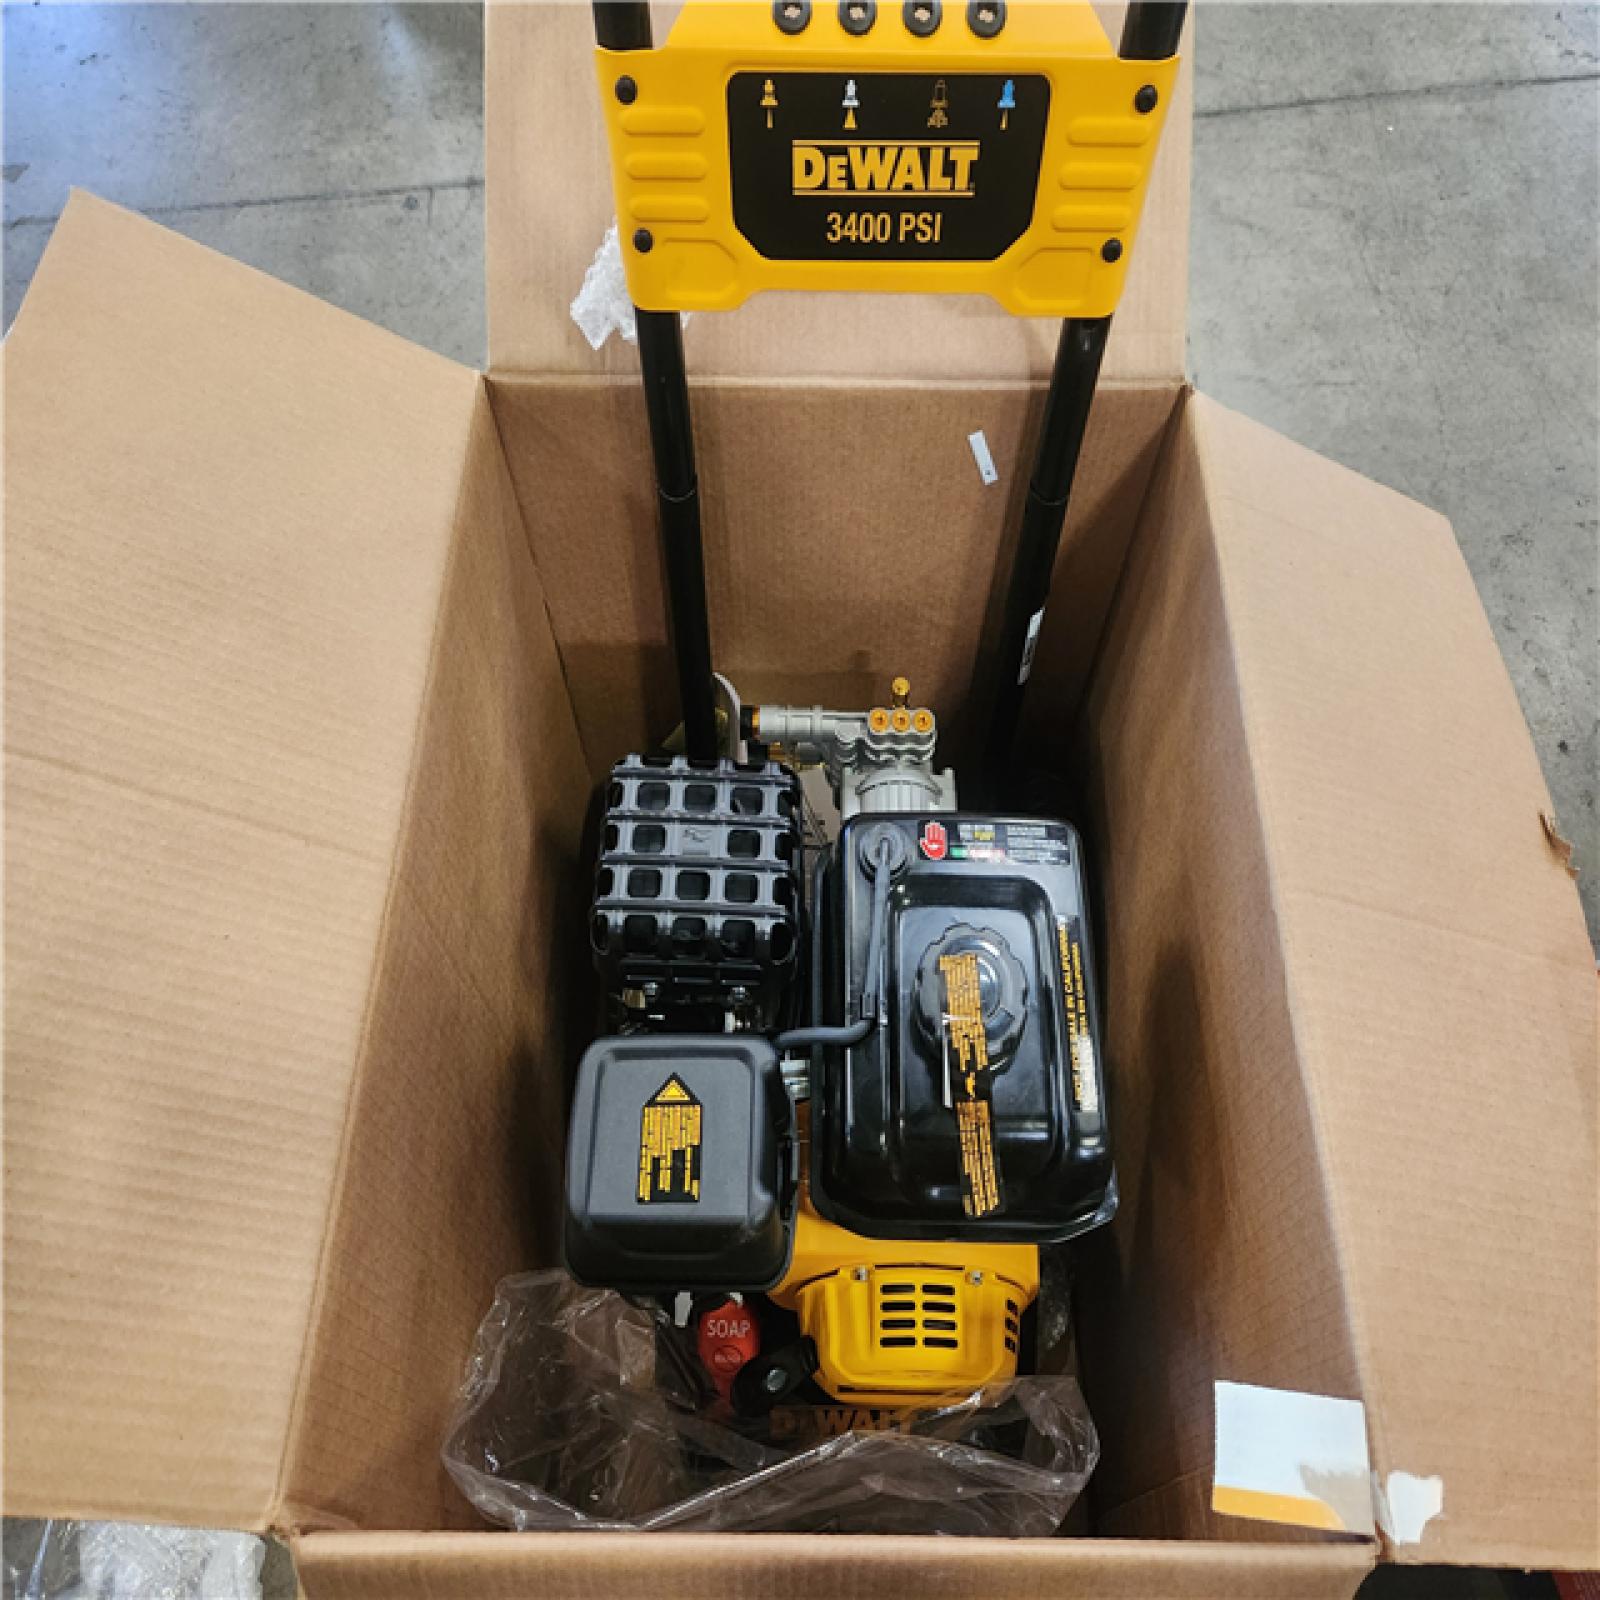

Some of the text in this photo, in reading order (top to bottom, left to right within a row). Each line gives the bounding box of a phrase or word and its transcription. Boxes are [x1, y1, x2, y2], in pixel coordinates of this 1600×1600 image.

[826, 212, 942, 244] 3400 PSI
[706, 1319, 751, 1338] SOAP
